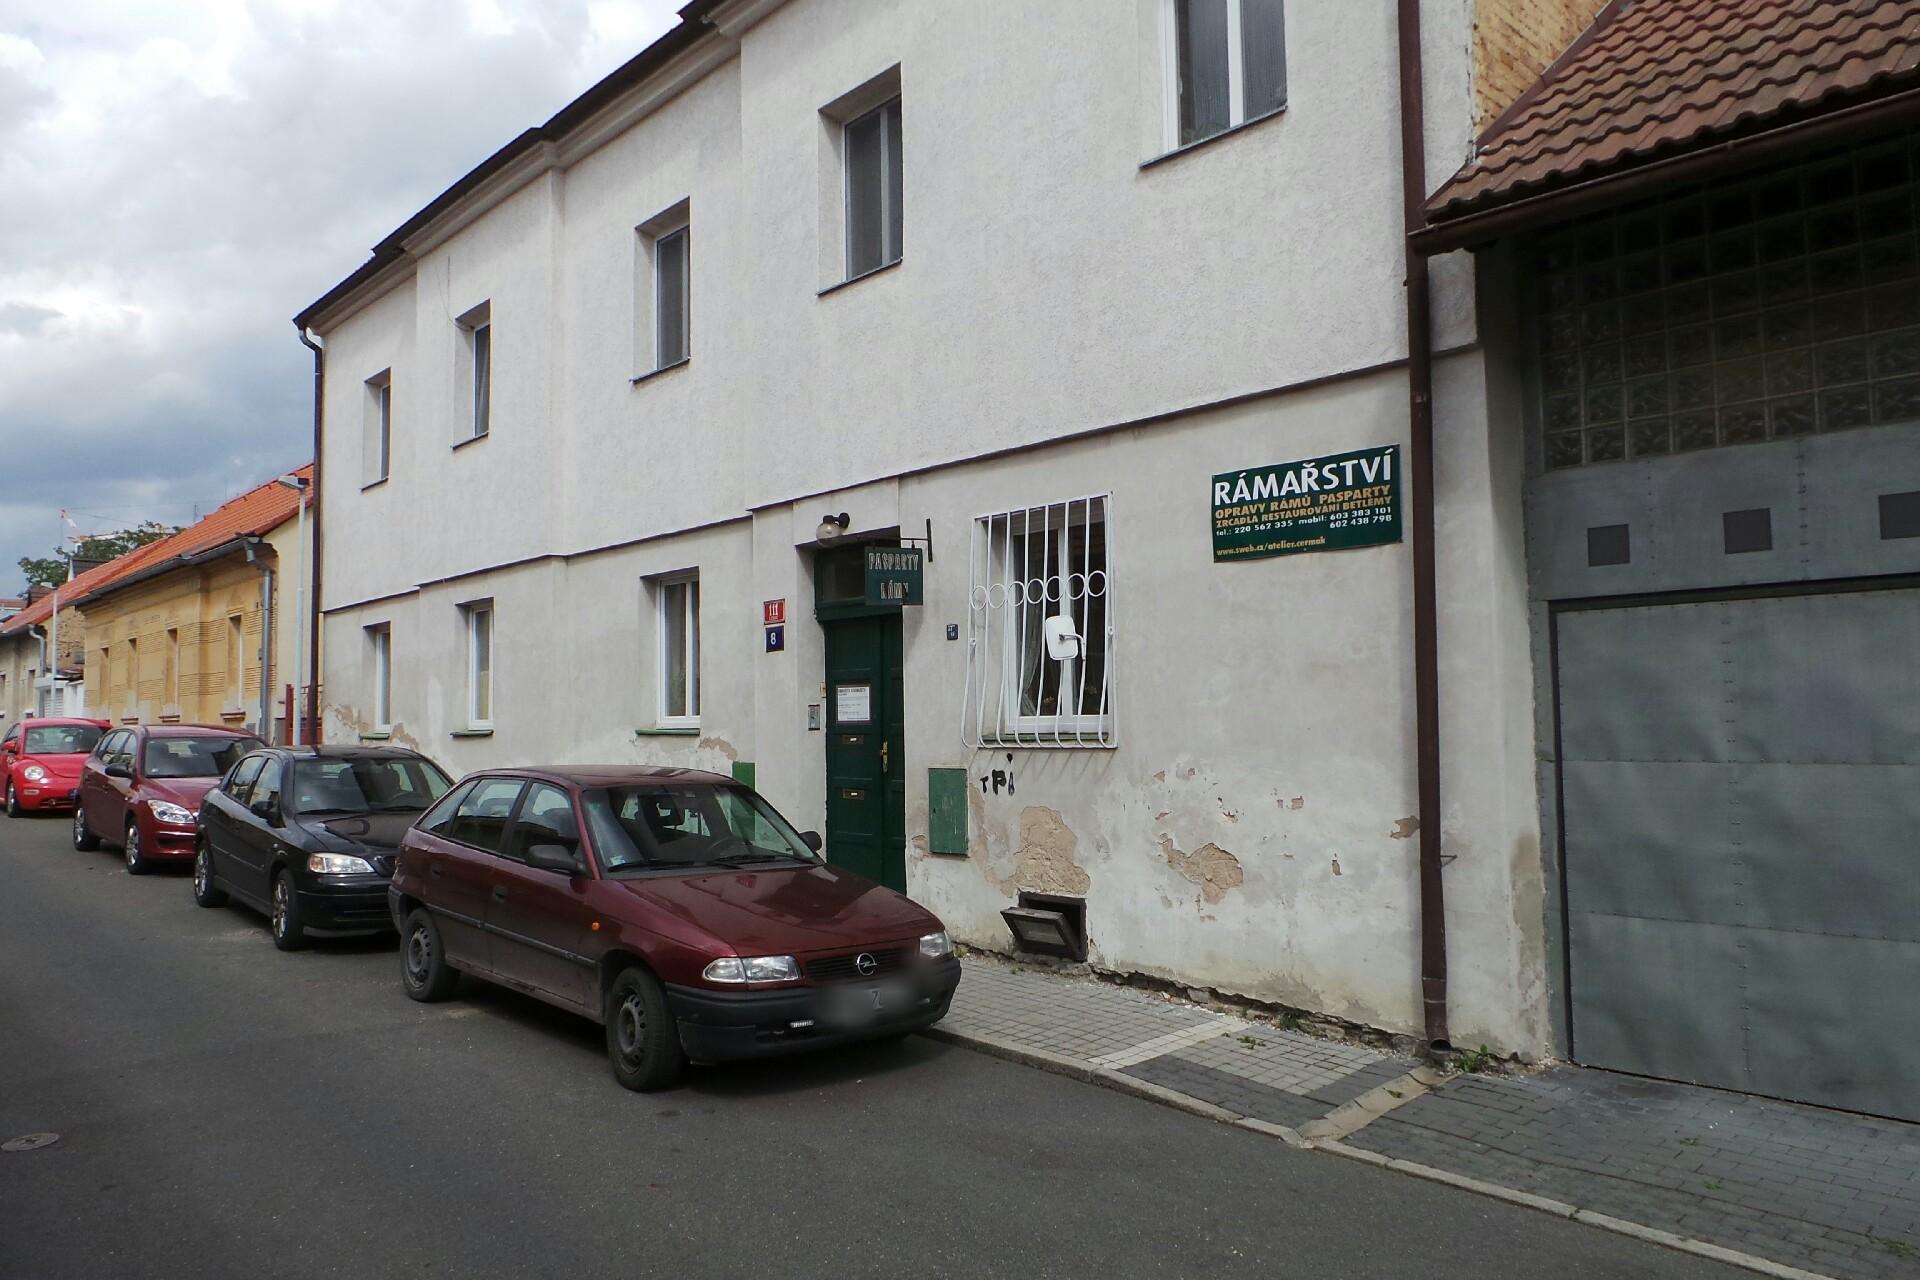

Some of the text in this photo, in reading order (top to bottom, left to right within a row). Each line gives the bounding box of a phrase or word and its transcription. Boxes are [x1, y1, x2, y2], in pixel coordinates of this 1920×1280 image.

[1214, 448, 1394, 506] RÁMAŘSTVÍ
[1215, 485, 1391, 519] OPRAVY RÁMŮ PASPARTY
[1216, 515, 1259, 528] ZRCADLA
[1234, 525, 1251, 534] 220
[1254, 522, 1271, 531] 562
[1274, 520, 1293, 529] 335
[1298, 515, 1327, 526] mobil:
[1330, 512, 1348, 521] 603
[1351, 509, 1371, 518] 383
[1375, 506, 1391, 515] 101
[1329, 514, 1392, 529] 602 438 798
[868, 552, 919, 571] PASPARTY
[770, 632, 777, 645] 8
